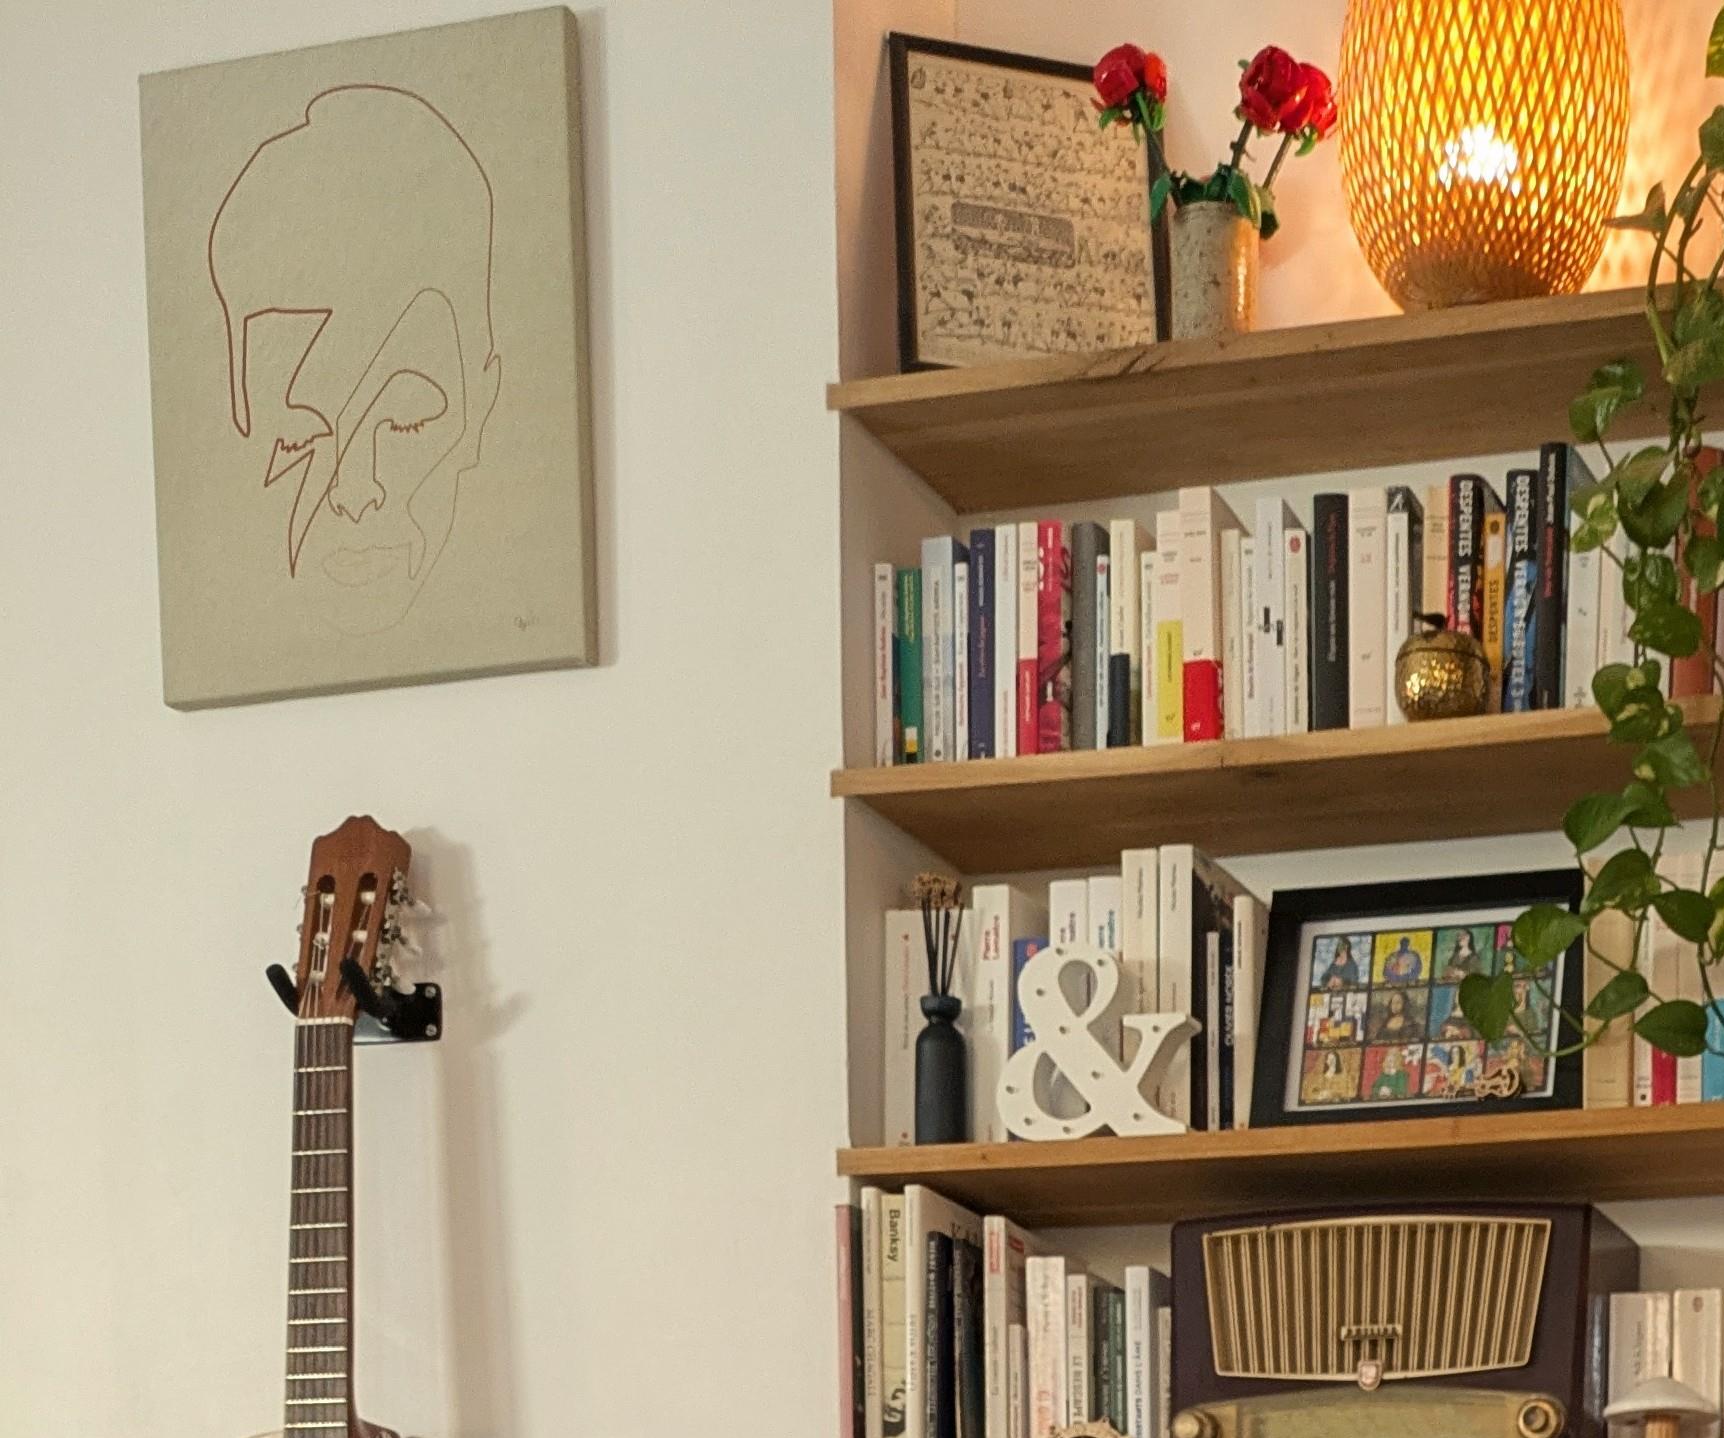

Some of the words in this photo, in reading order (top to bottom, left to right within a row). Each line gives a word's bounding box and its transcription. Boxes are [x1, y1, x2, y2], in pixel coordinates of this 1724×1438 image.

[1458, 480, 1473, 556] DESPENTES
[1513, 474, 1529, 552] DESPENTES
[1457, 564, 1471, 621] VERNON
[1487, 579, 1499, 643] DESPENTES
[887, 1208, 901, 1262] Banksy
